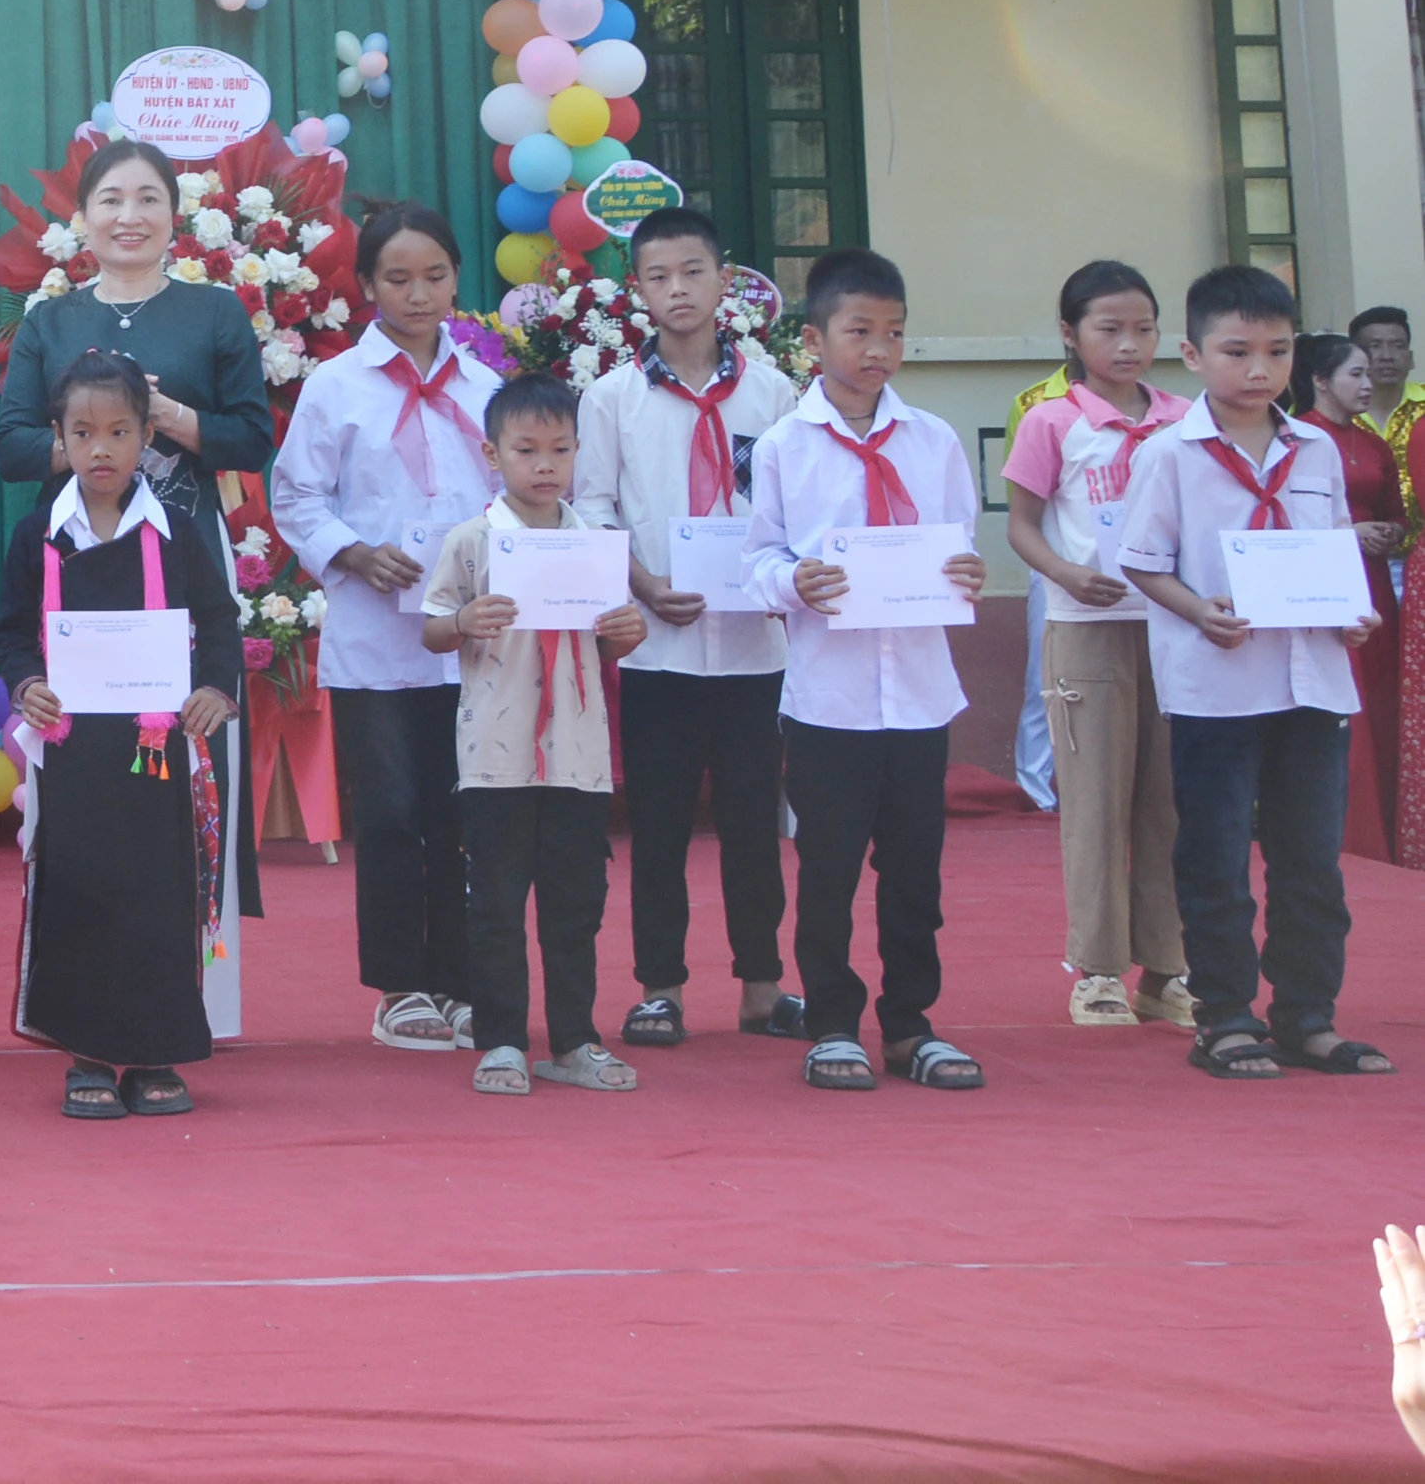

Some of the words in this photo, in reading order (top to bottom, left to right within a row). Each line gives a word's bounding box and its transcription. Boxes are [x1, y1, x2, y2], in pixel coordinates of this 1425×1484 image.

[132, 74, 163, 92] HUYỆN
[165, 71, 178, 89] ỦY
[187, 77, 213, 90] HĐND
[223, 78, 249, 90] UBND
[144, 95, 183, 110] HUYỆN
[187, 95, 209, 107] BÁT
[213, 95, 235, 108] XÁT
[138, 112, 182, 128] Chúc
[185, 113, 240, 132] Mừng
